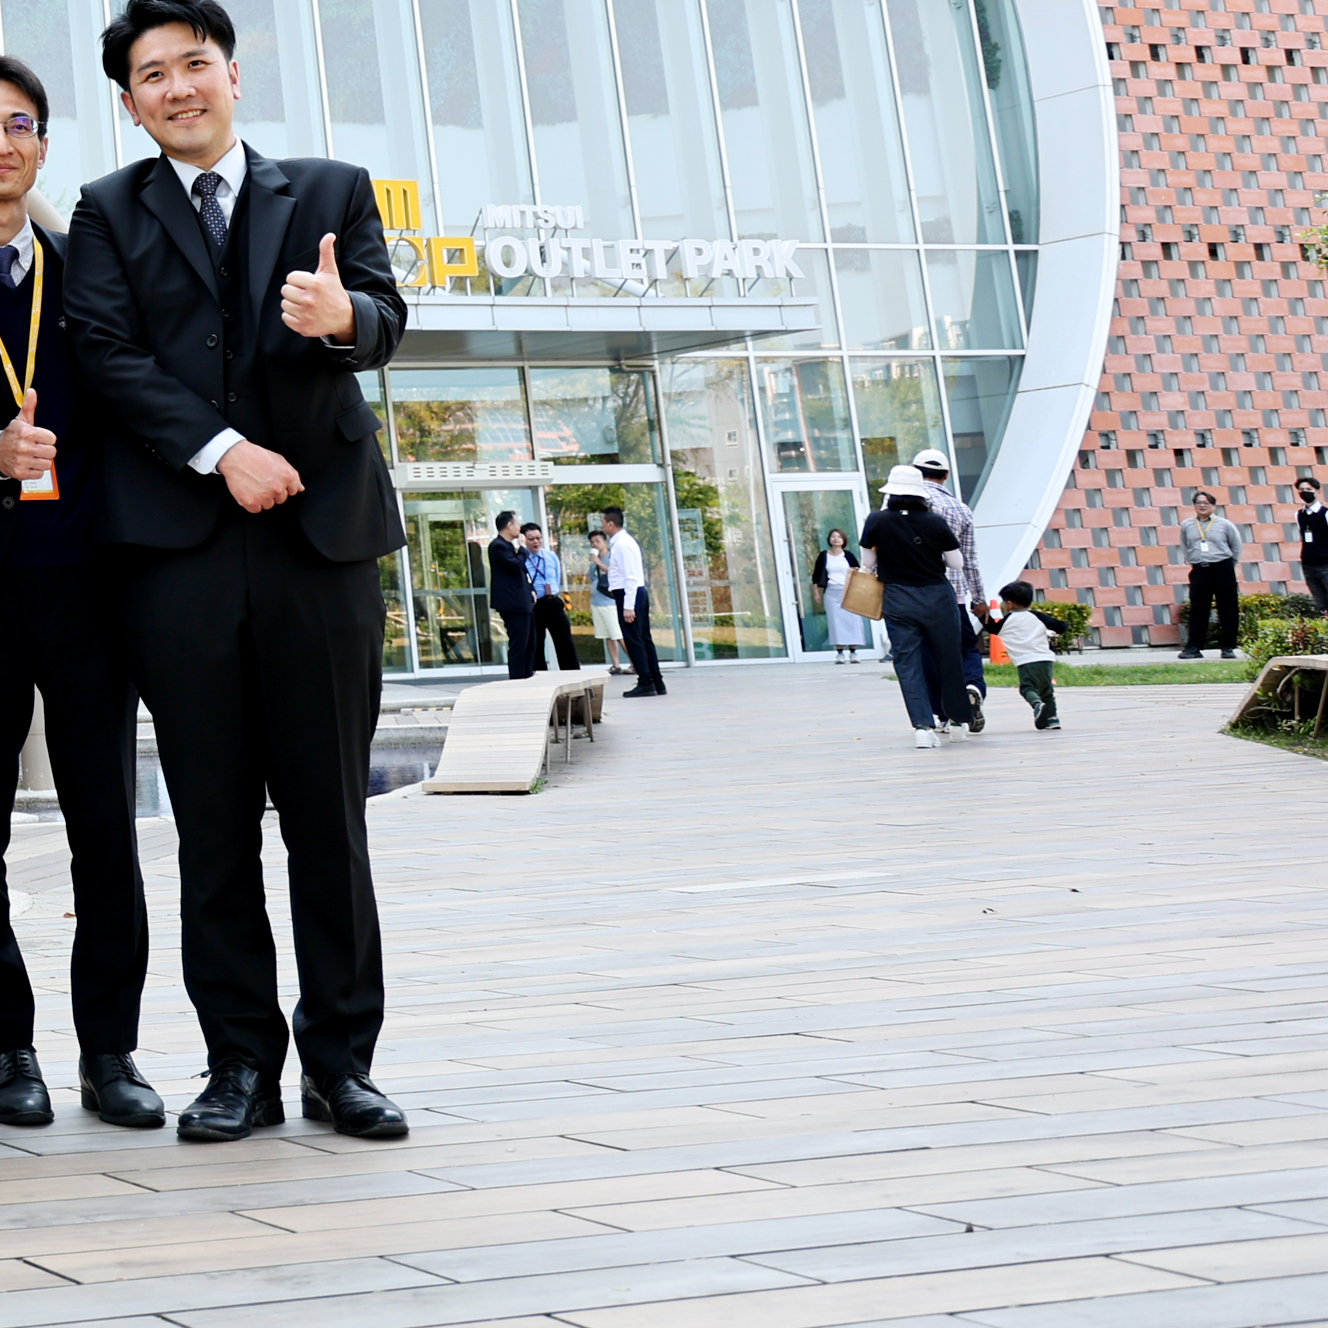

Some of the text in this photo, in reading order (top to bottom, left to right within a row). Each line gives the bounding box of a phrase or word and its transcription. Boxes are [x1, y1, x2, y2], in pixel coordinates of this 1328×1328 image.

[482, 204, 584, 229] MITSUI
[485, 236, 806, 279] OUTLET PARK
